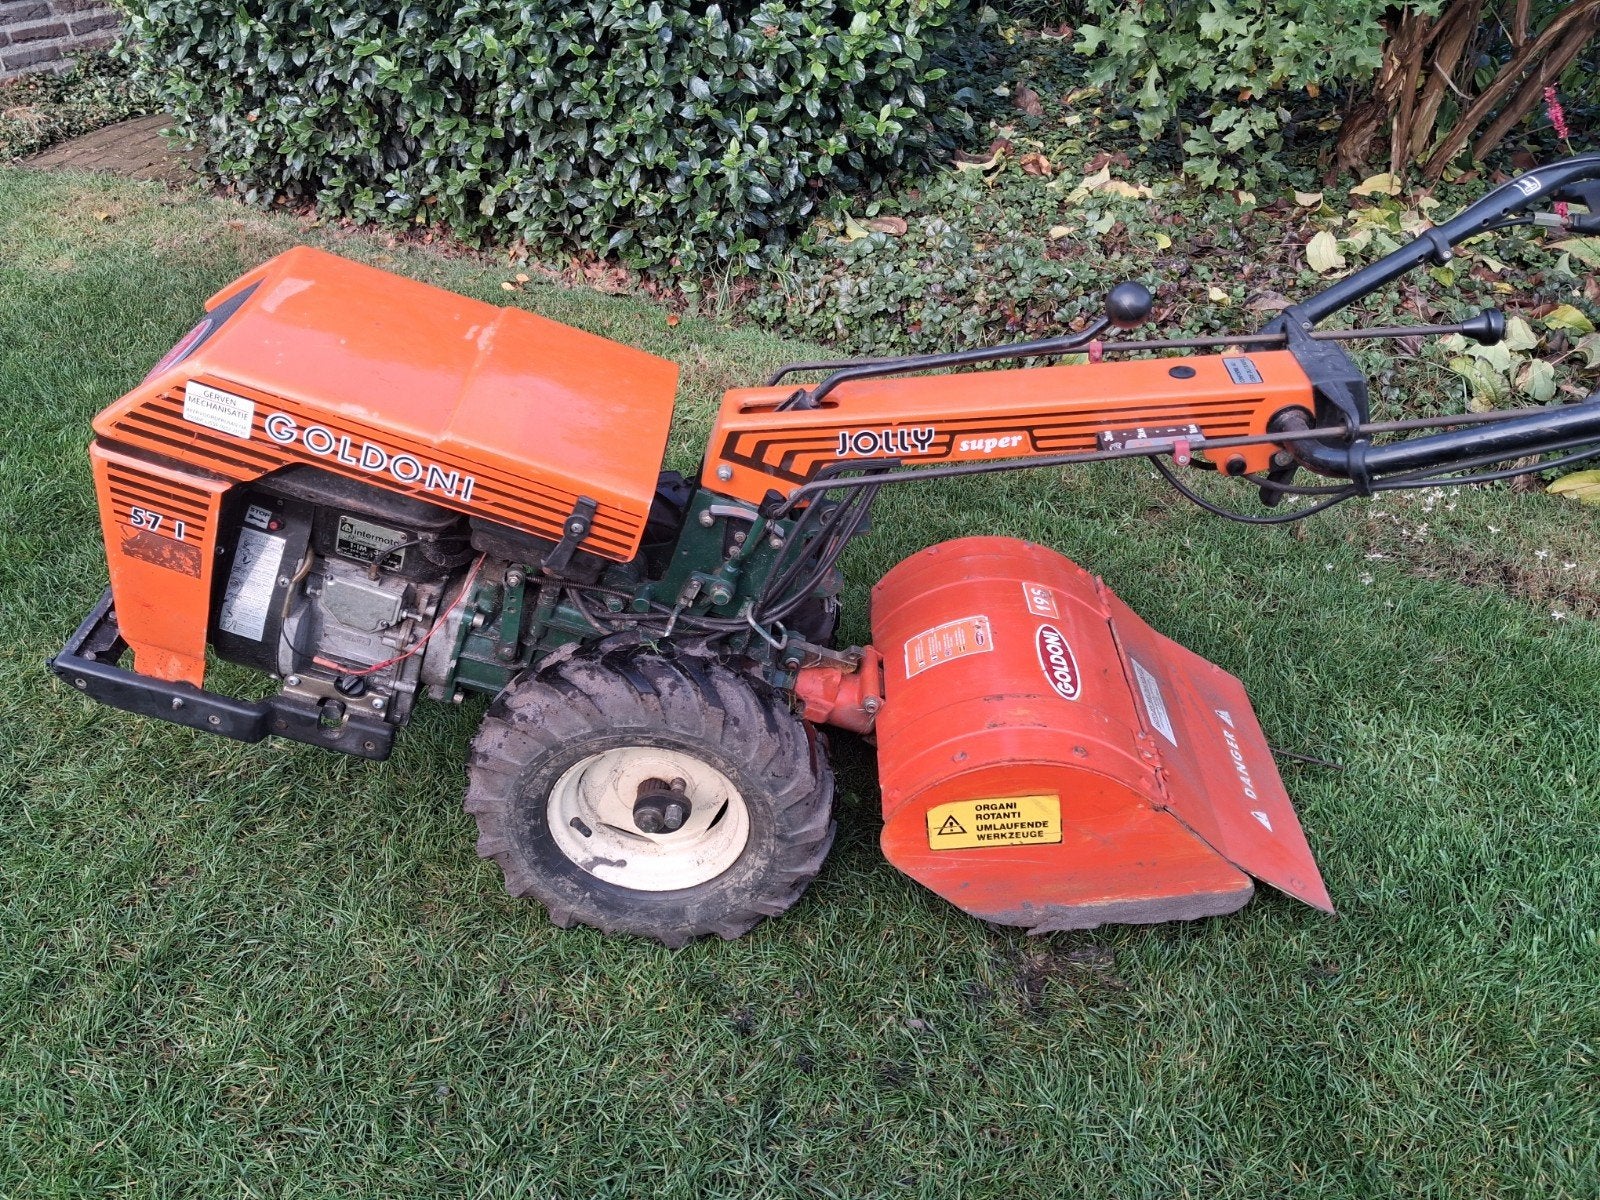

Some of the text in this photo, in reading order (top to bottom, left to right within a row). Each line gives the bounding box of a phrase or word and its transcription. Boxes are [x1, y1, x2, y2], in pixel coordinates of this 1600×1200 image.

[188, 395, 249, 420] MECHANISATIE
[203, 390, 237, 406] GERVEN
[836, 427, 1022, 456] JOLLY super
[265, 412, 475, 502] GOLDONI
[130, 506, 163, 532] 57
[249, 506, 271, 518] STOP
[1041, 630, 1075, 695] GOLDONI
[1222, 729, 1257, 800] DANGER
[974, 802, 1017, 812] ORGANI
[975, 811, 1021, 821] ROTANTI
[976, 820, 1049, 832] UMLAUFENDE
[976, 830, 1044, 842] WERKZEUGE
